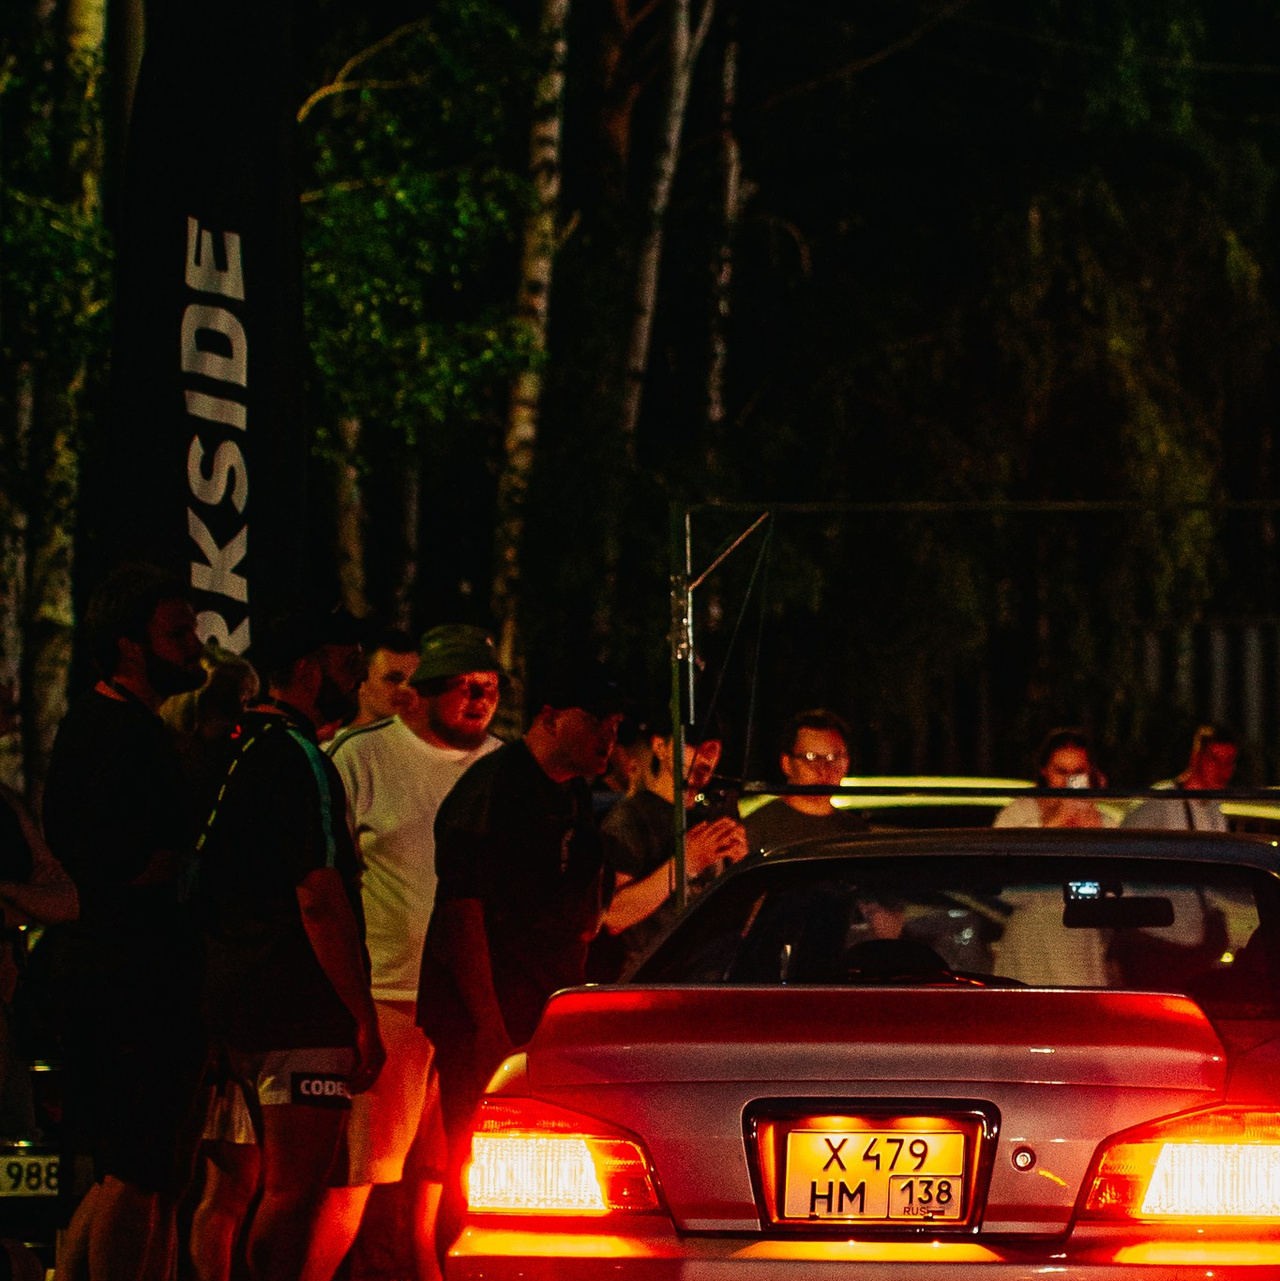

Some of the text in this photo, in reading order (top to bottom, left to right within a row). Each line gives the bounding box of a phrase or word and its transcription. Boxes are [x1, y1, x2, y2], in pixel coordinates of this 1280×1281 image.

[862, 1138, 929, 1171] 479
[900, 1179, 953, 1205] 138
[903, 1206, 926, 1216] RUS
